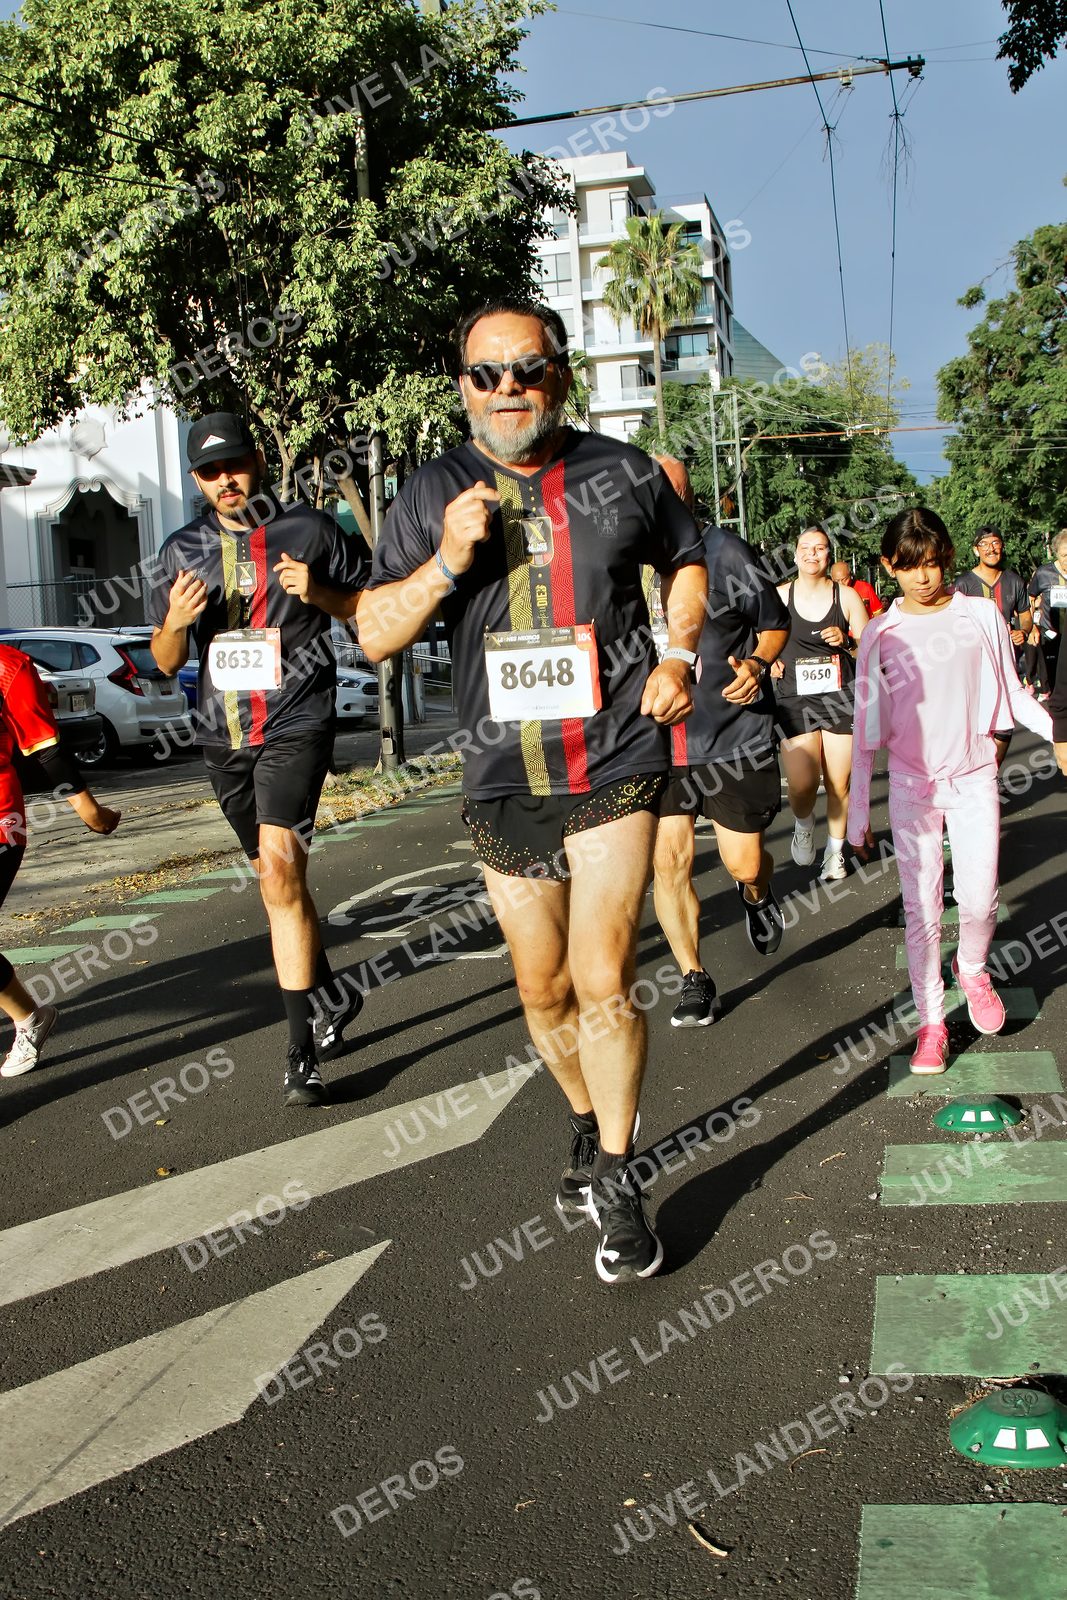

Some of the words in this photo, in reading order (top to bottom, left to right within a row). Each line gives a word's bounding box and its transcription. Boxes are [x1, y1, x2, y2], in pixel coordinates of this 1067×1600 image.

[216, 649, 263, 670] 8632
[500, 657, 575, 690] 8648
[802, 668, 831, 682] 9650
